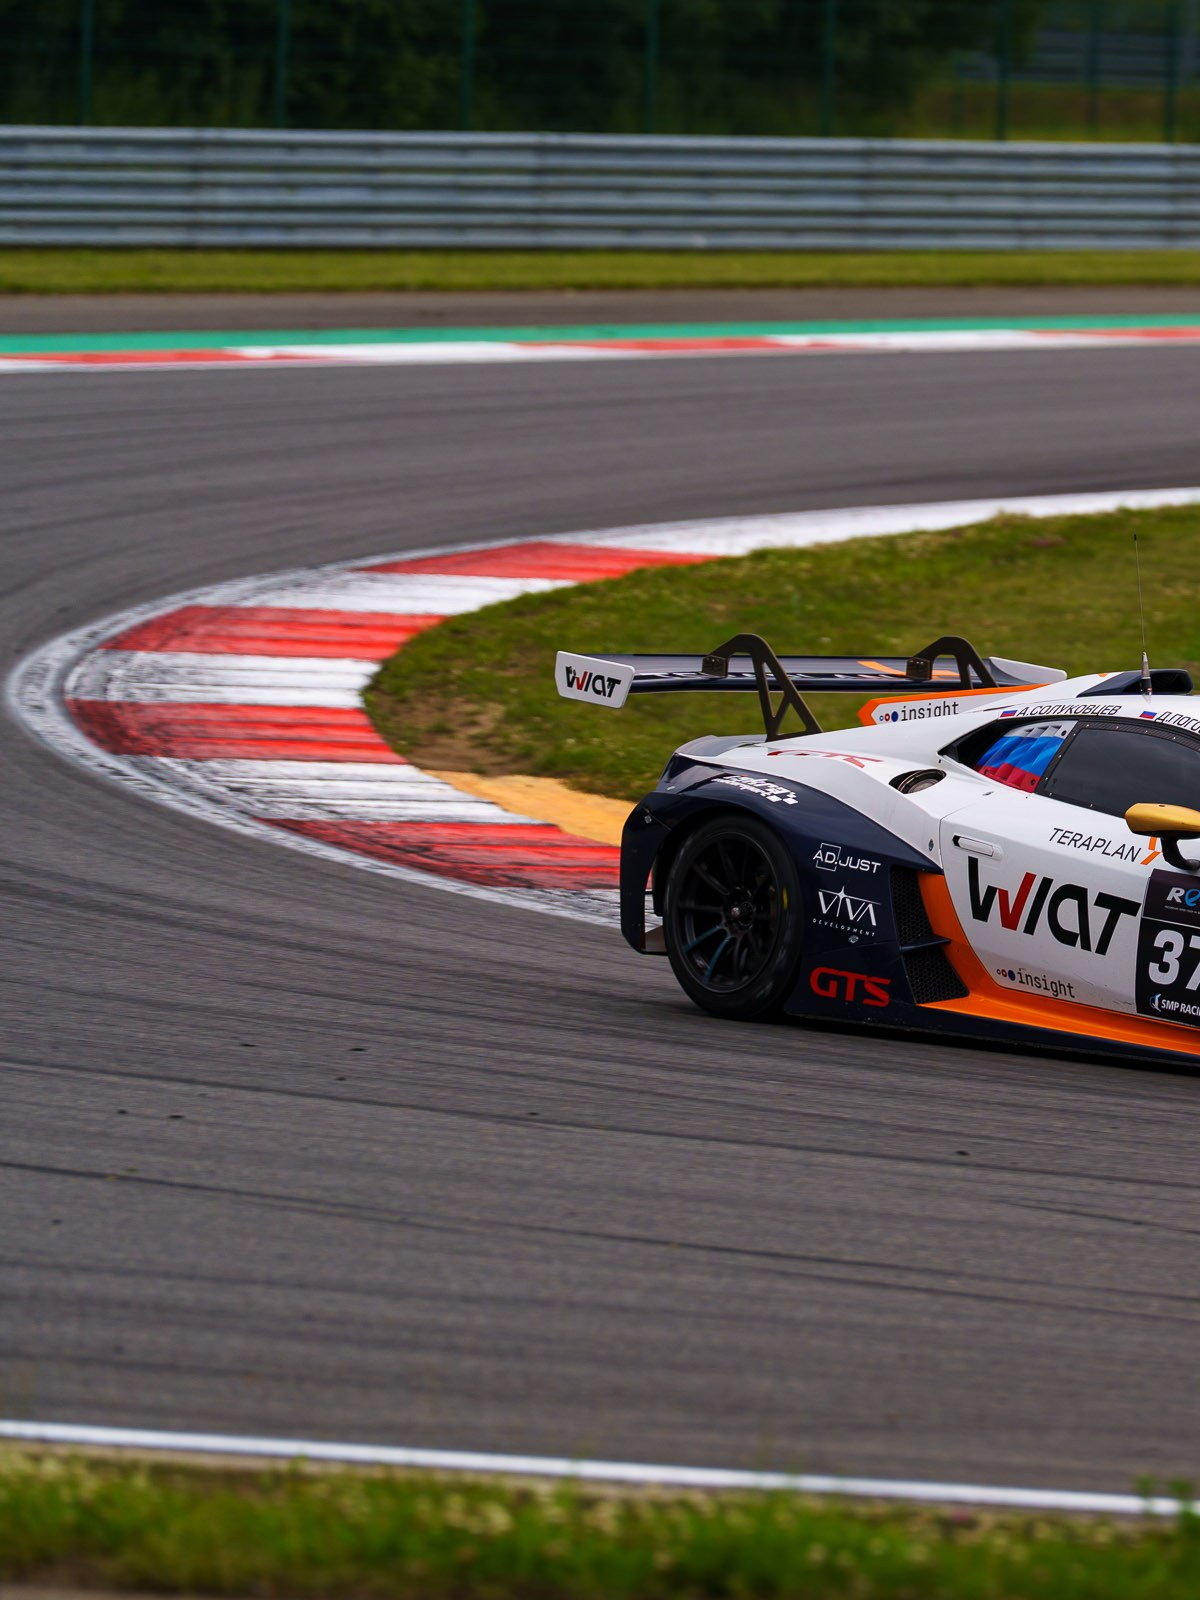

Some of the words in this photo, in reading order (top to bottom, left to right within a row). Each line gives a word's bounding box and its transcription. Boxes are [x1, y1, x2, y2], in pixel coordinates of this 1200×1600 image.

[901, 701, 959, 721] insight
[1049, 827, 1141, 863] TERAPLAN
[818, 886, 881, 926] VIVA
[812, 918, 876, 937] DEVELOPMENT
[810, 966, 891, 1007] GTS
[1018, 967, 1075, 998] insight
[1161, 999, 1179, 1012] SMP
